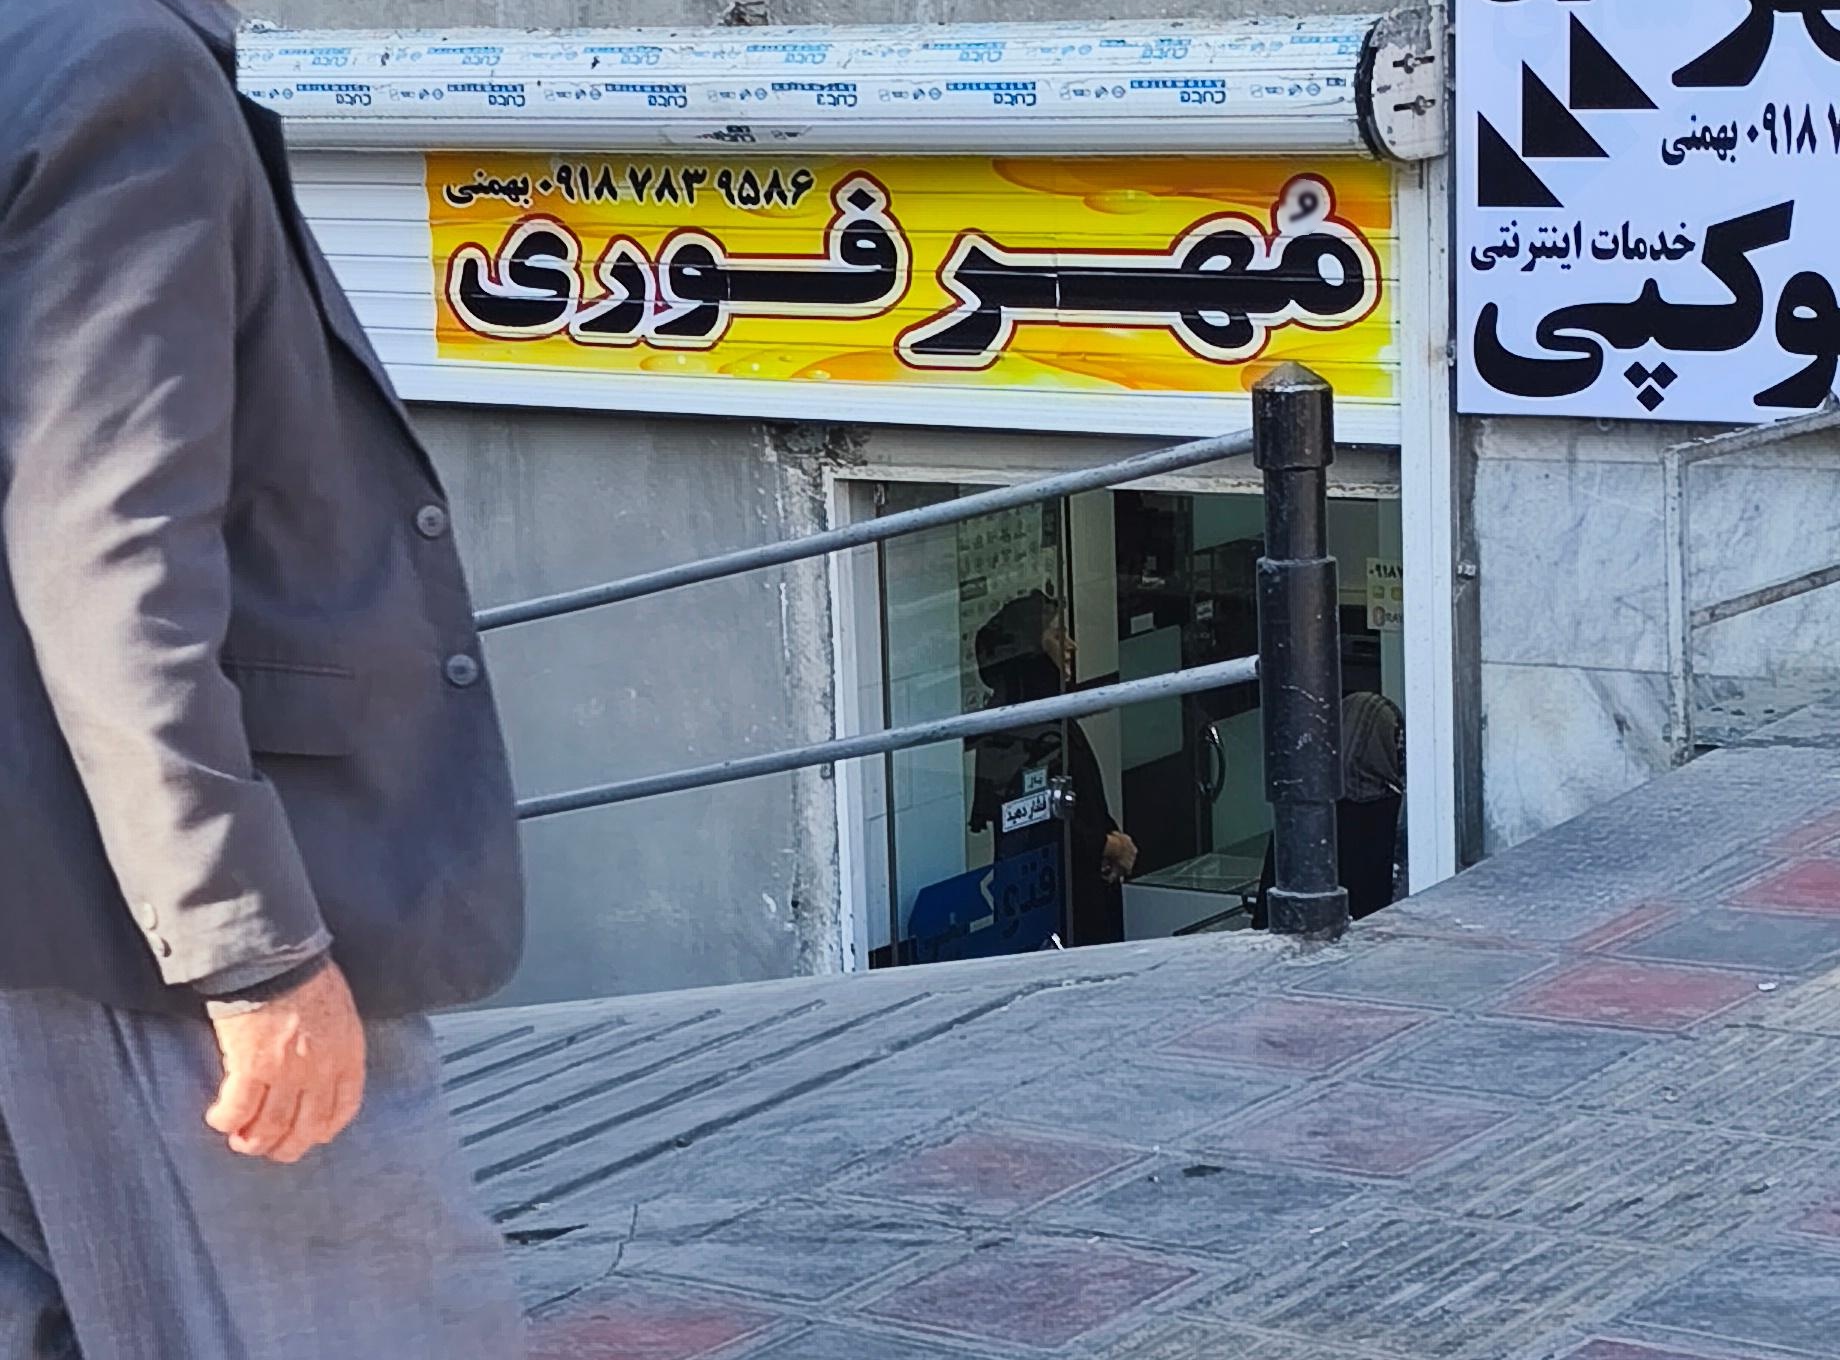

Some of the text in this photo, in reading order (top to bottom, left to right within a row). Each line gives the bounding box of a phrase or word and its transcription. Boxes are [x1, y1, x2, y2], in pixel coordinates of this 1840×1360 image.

[1661, 114, 1738, 166] بهمنی
[1747, 102, 1817, 155] ۰۹۱۸
[445, 163, 814, 211] ۰۹۱۸ ۷۸۳ ۹۵۸۶ بهمنی
[450, 178, 902, 344] فوری
[1470, 219, 1697, 272] خدمات اینترنتی
[1472, 199, 1840, 413] وکپی
